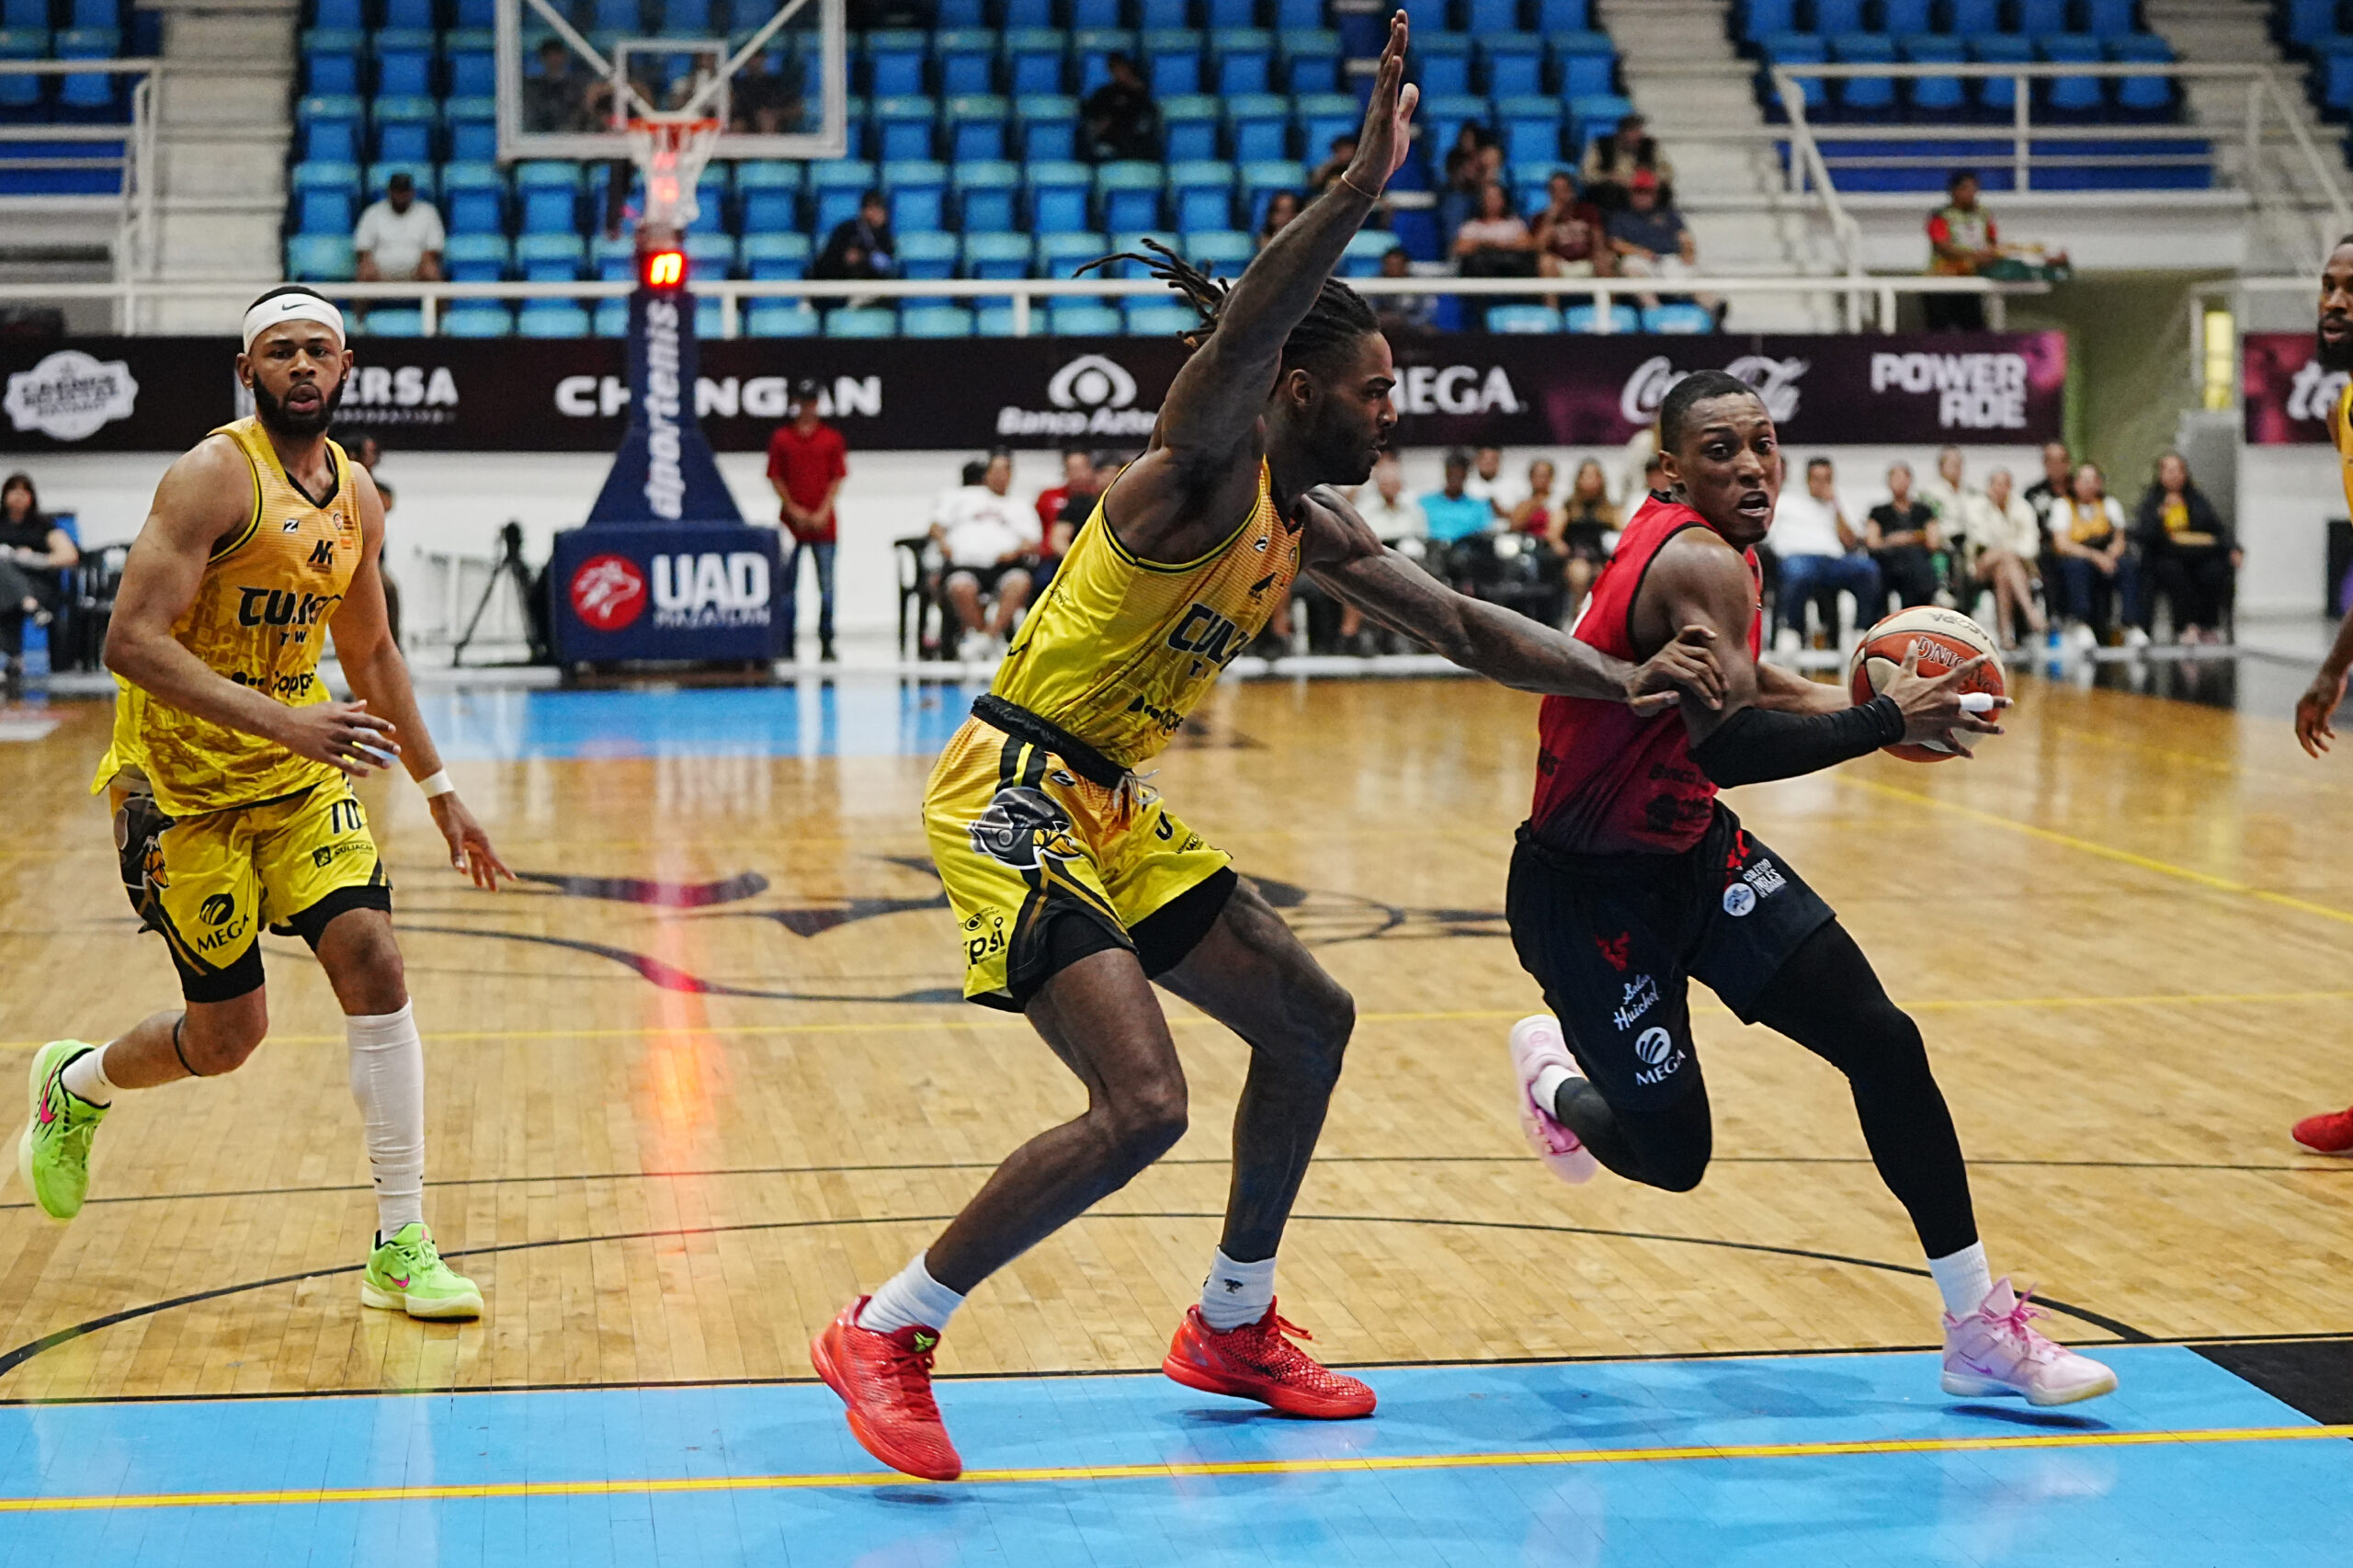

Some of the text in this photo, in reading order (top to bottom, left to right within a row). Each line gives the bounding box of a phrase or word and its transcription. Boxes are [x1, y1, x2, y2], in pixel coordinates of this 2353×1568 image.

[339, 365, 460, 406] ERSA
[1871, 353, 2027, 393] POWER
[554, 375, 882, 417] CHNGN
[643, 301, 686, 519] dportenis
[1089, 405, 1159, 436] Azte
[652, 551, 770, 609] UAD
[332, 799, 362, 834] 10
[196, 913, 250, 953] MEGA
[1613, 980, 1660, 1031] Huichol
[1635, 1049, 1687, 1086] MEGA
